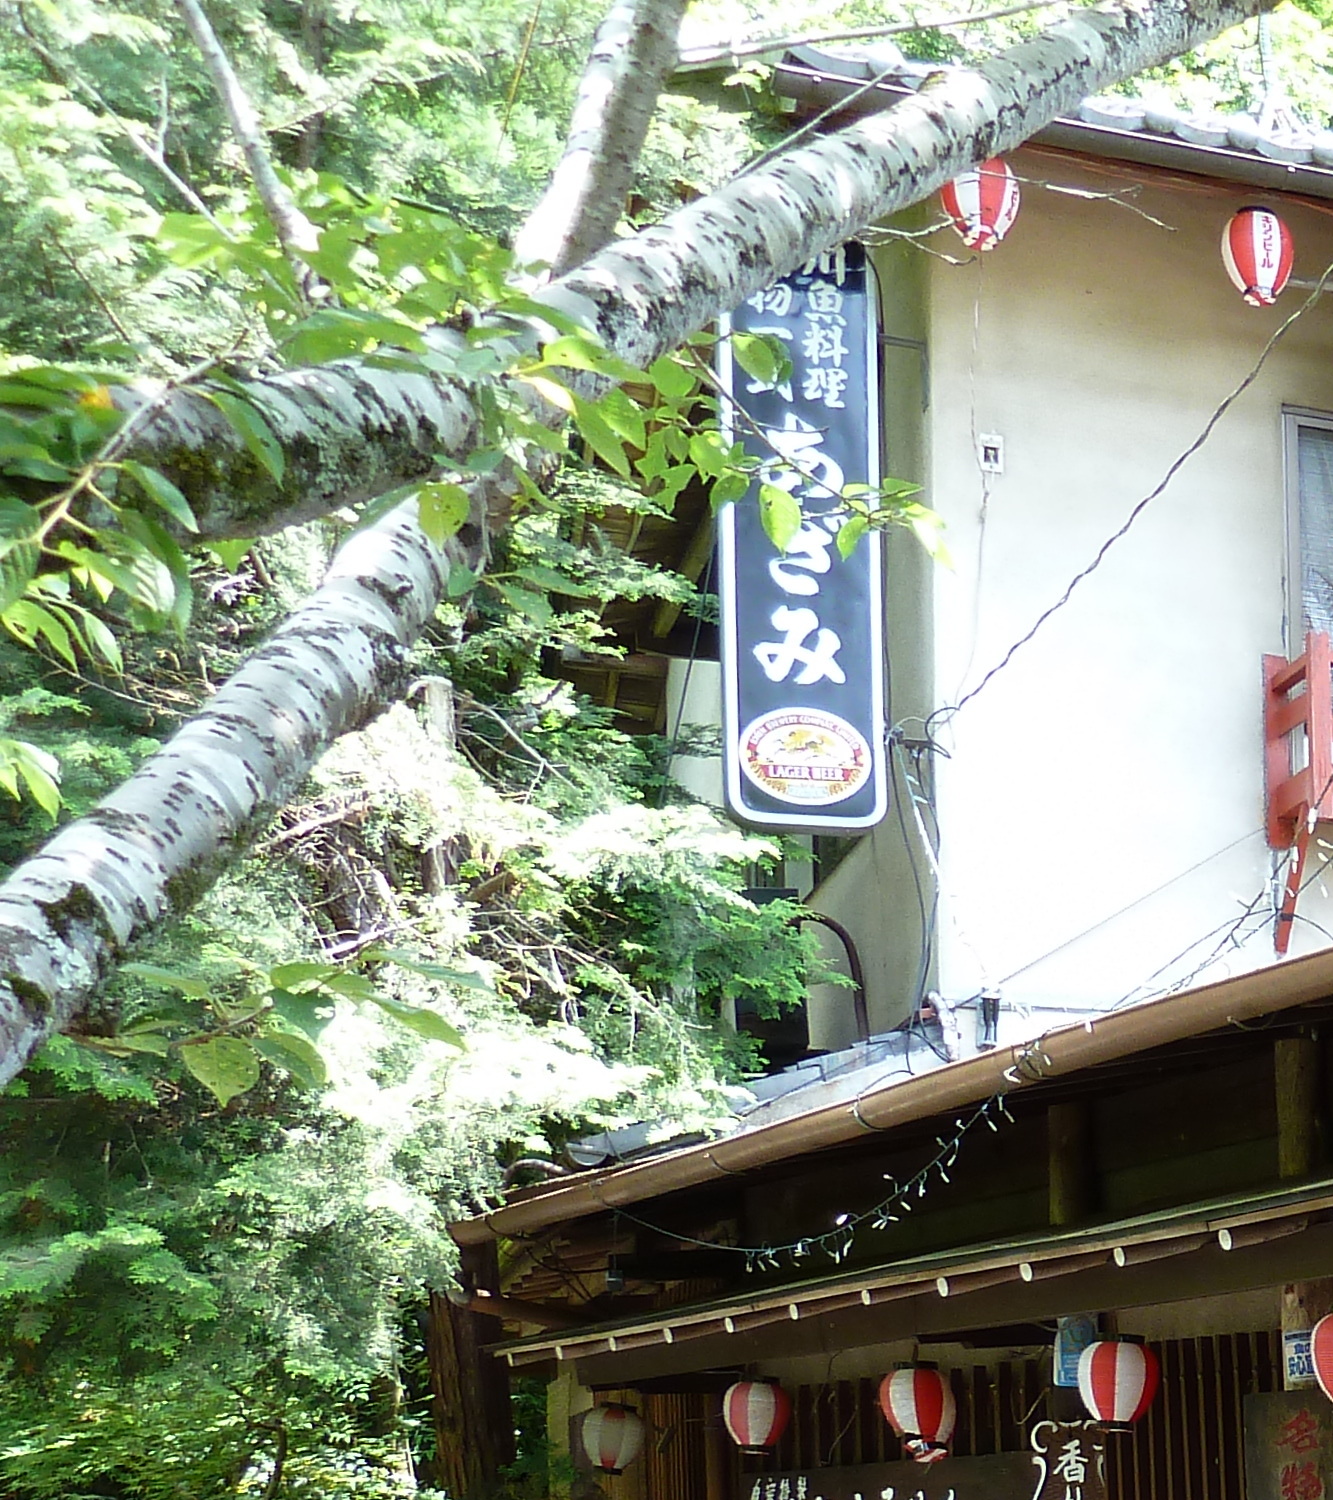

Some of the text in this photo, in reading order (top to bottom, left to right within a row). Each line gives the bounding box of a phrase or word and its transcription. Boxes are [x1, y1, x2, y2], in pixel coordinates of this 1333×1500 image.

[1260, 214, 1275, 269] キリンビール
[752, 411, 847, 686] あざみ
[766, 766, 846, 781] LAGER BEER
